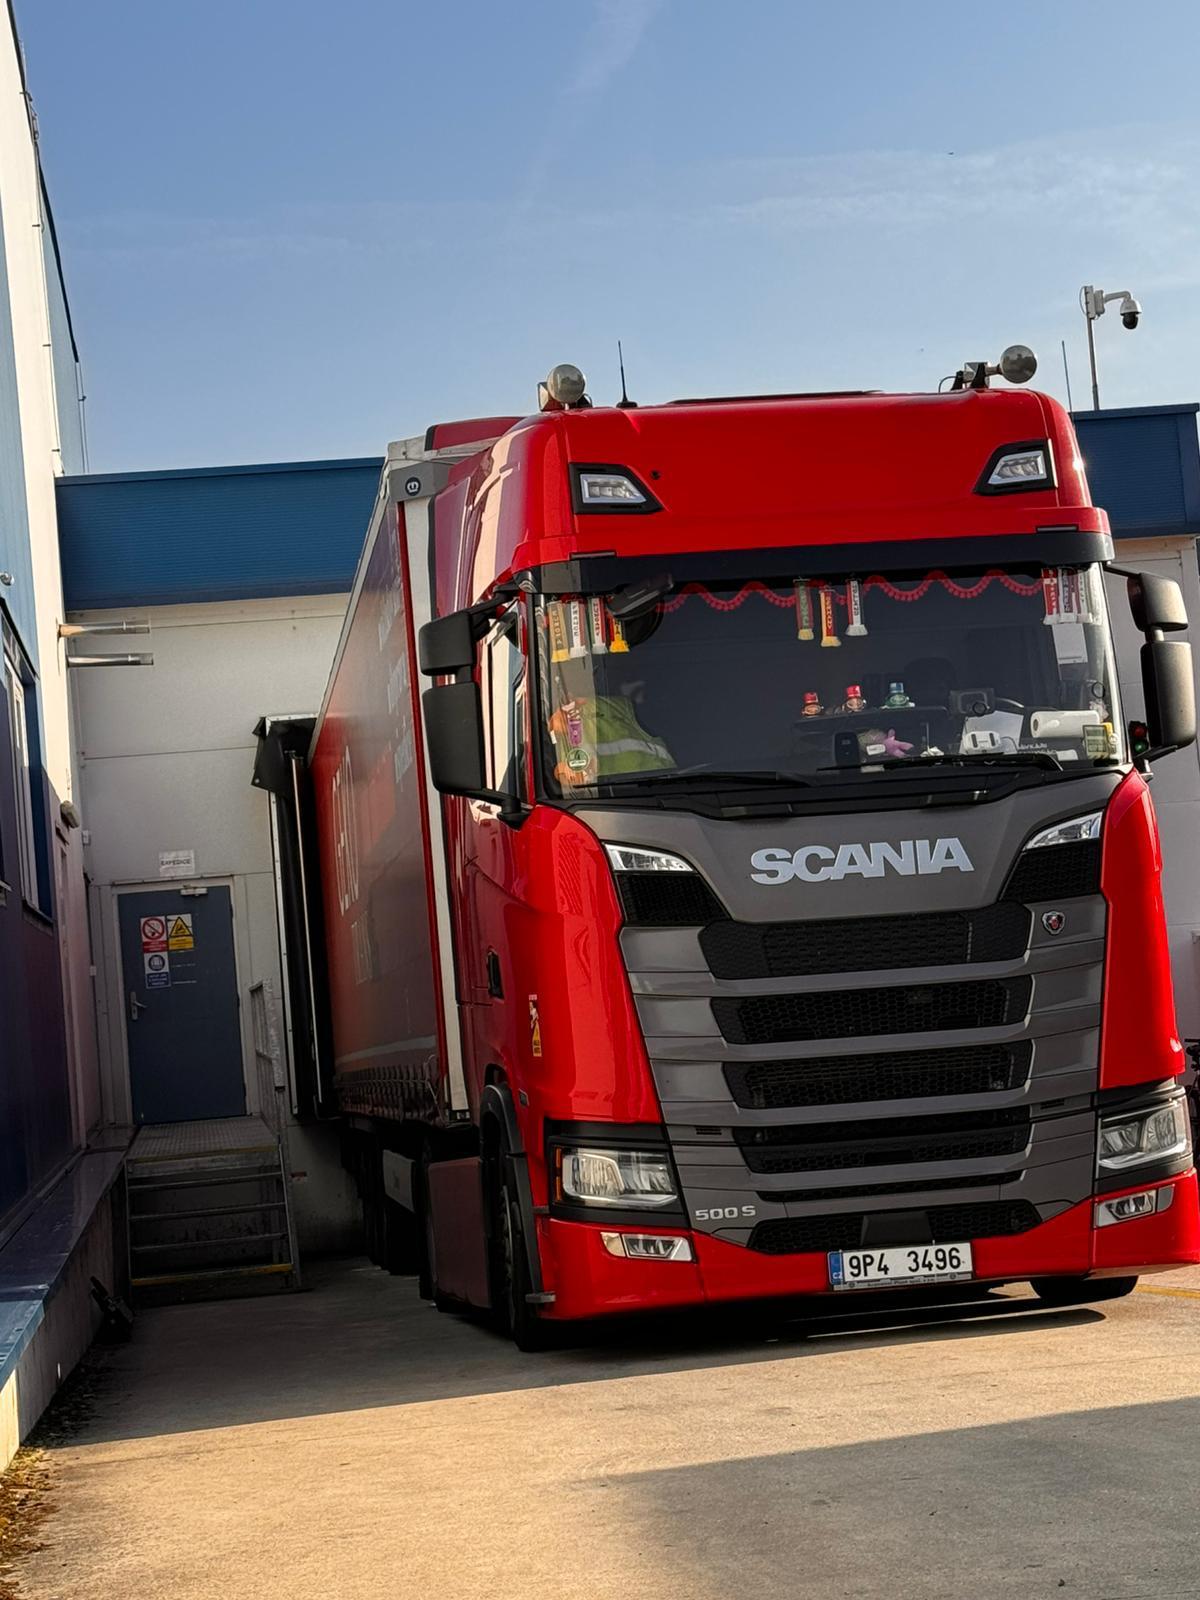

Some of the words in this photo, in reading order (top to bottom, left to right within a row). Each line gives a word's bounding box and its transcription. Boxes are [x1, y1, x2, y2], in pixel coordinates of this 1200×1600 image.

[750, 836, 975, 885] SCANIA
[695, 1205, 739, 1221] 500
[741, 1204, 756, 1218] S
[849, 1252, 890, 1278] 9P4
[906, 1247, 962, 1273] 3496
